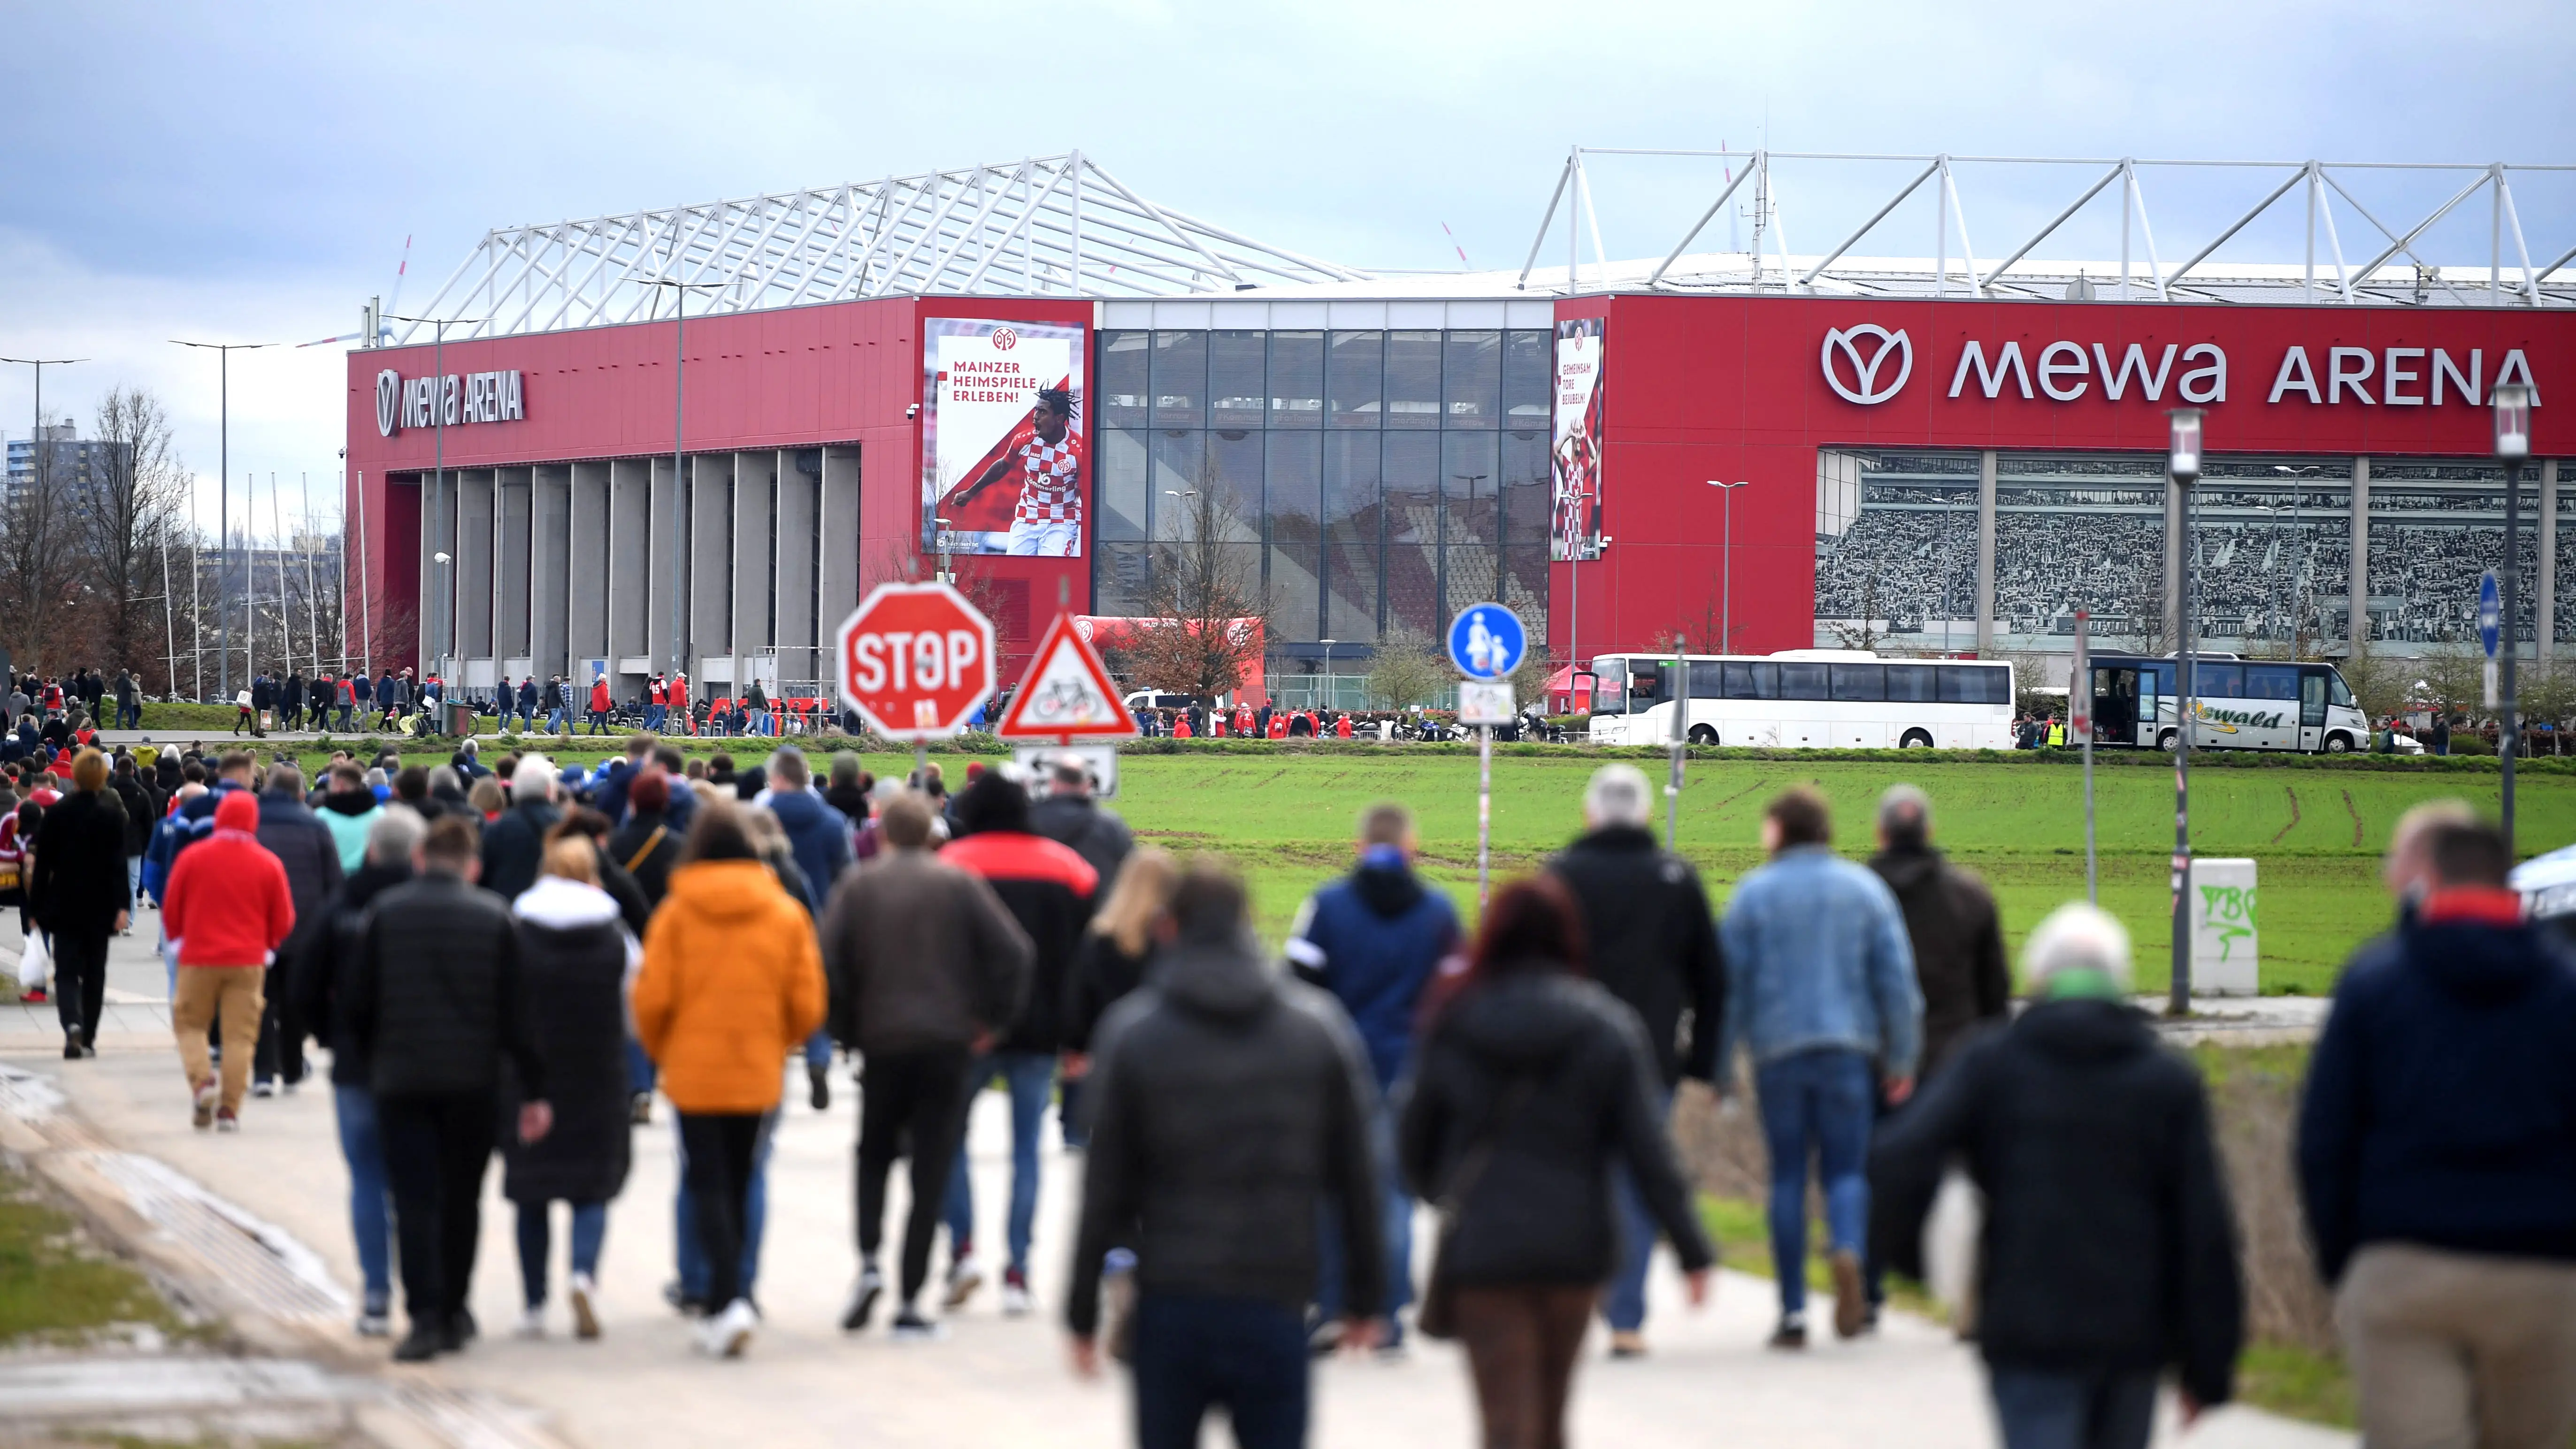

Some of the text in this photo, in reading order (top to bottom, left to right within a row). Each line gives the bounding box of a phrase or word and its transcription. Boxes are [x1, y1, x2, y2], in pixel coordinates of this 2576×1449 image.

[954, 361, 1020, 374] MAINZER
[1563, 362, 1591, 376] GEMEINSAM
[2267, 345, 2542, 406] ARENA
[953, 376, 1036, 389] HEIMSPIELE
[1563, 379, 1574, 390] TORE
[462, 370, 523, 423] ARENA
[953, 391, 1019, 403] ERLEBEN!
[1562, 393, 1586, 405] BEJUBELN!
[854, 629, 979, 693] STOP
